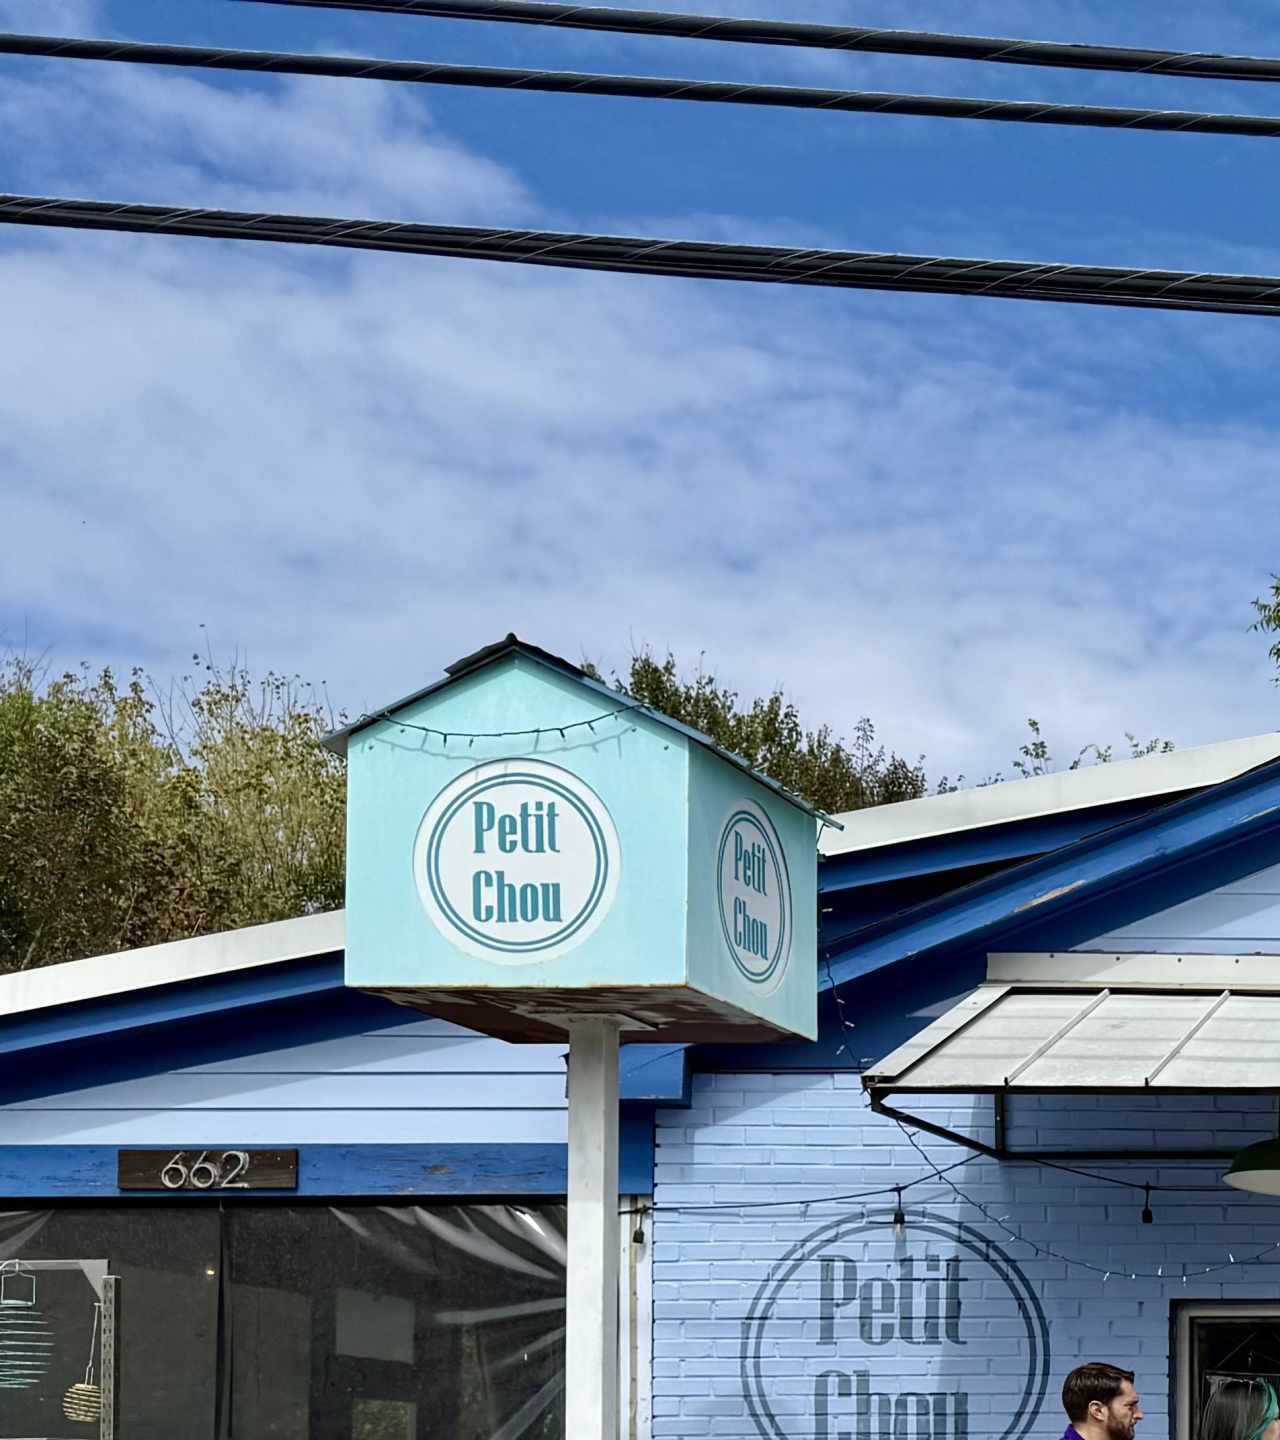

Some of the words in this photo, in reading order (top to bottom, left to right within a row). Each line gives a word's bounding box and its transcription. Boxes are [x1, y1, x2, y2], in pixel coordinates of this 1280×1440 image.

[473, 801, 560, 854] Petit
[733, 830, 767, 897] Petit
[472, 870, 562, 923] Chou
[733, 898, 768, 961] Chou
[160, 1151, 249, 1189] 662
[815, 1254, 968, 1346] Petit
